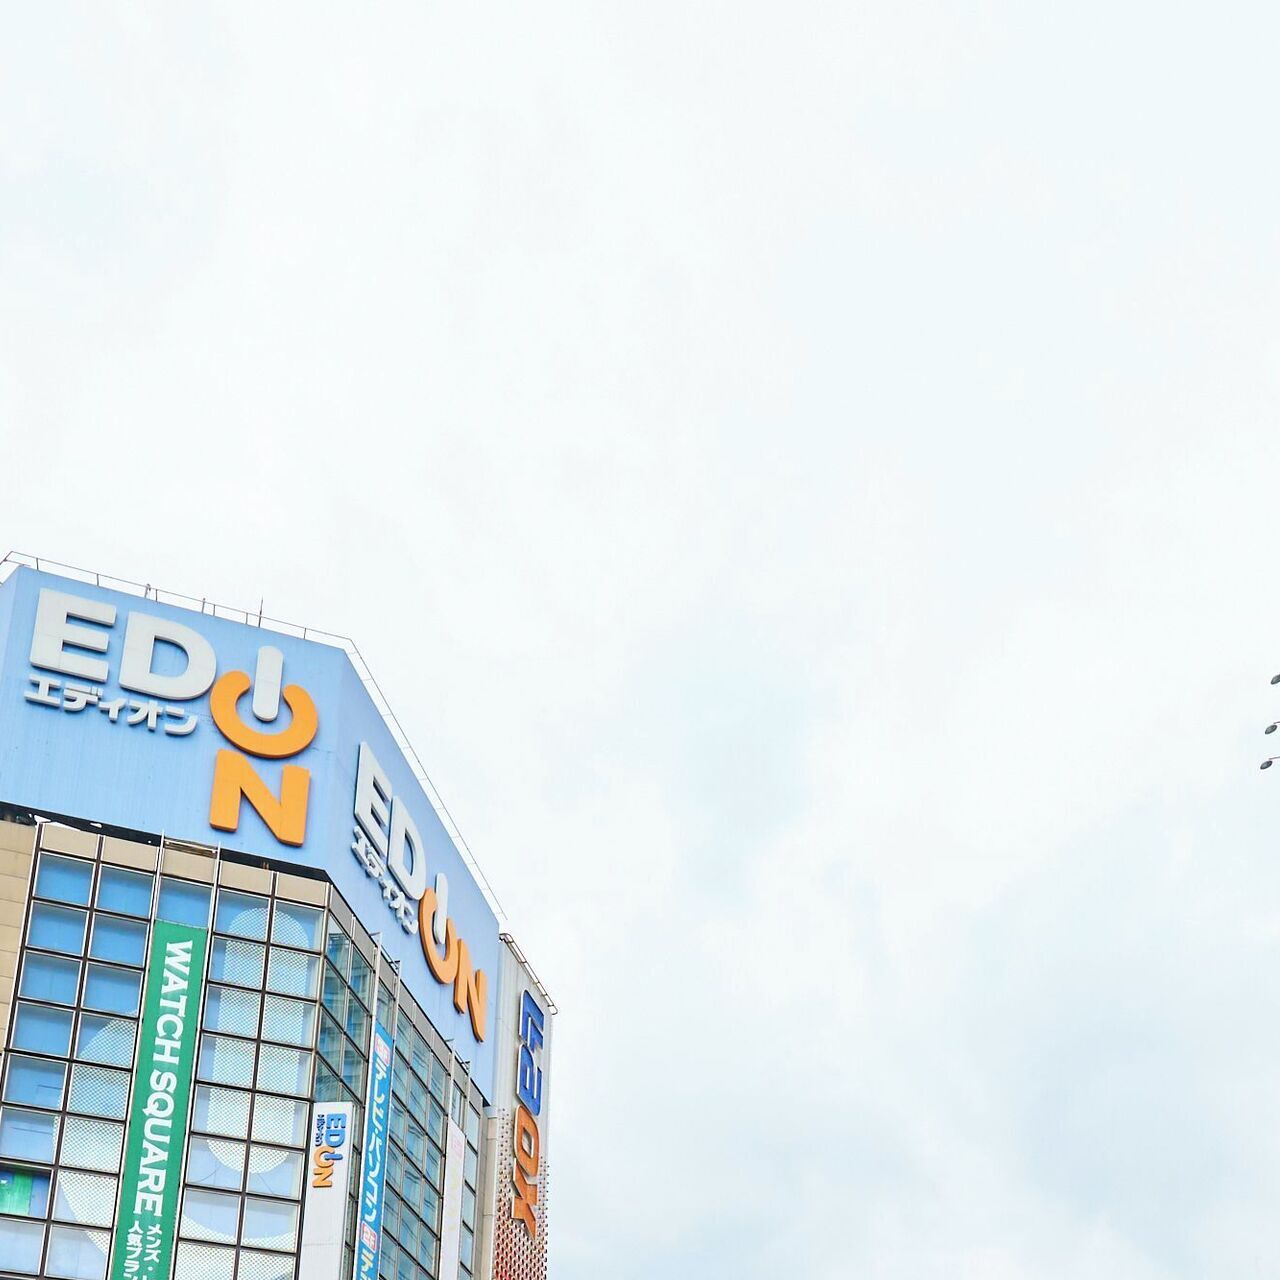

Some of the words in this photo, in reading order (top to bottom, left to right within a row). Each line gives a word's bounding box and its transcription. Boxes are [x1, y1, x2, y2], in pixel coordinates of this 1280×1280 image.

[24, 674, 198, 736] エディオン
[30, 588, 318, 847] EDION
[352, 826, 418, 936] エディオン
[354, 742, 488, 1043] EDION
[156, 940, 193, 1064] WATCH
[134, 1070, 177, 1217] SQUARE
[312, 1112, 346, 1189] EDION
